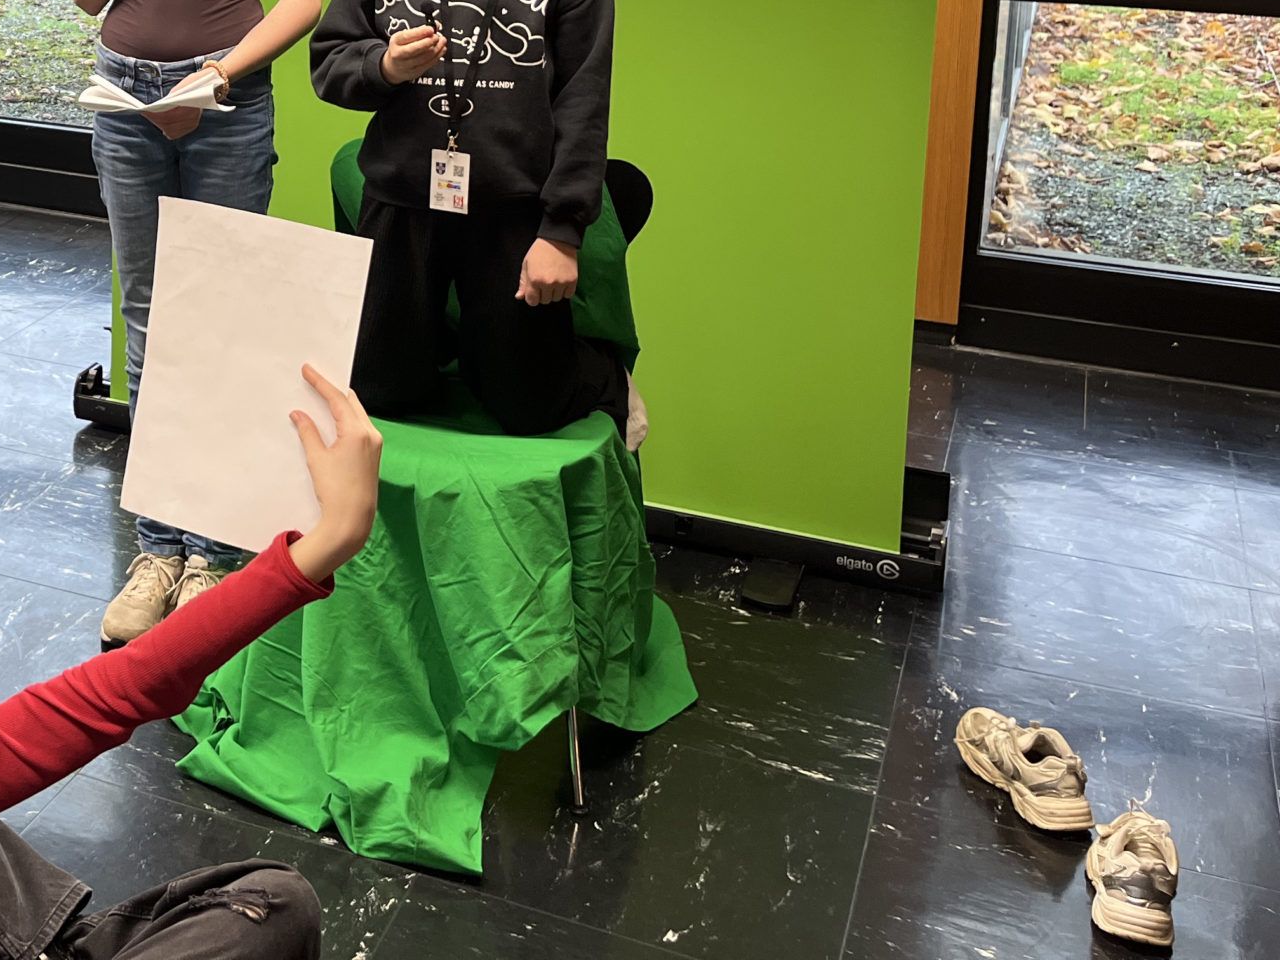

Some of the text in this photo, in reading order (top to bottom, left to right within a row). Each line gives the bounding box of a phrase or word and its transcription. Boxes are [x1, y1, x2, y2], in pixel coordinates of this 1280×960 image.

[417, 77, 433, 86] ARE
[434, 78, 446, 87] AS
[475, 80, 487, 89] AS
[488, 81, 515, 90] CANDY
[836, 555, 874, 572] elgato
